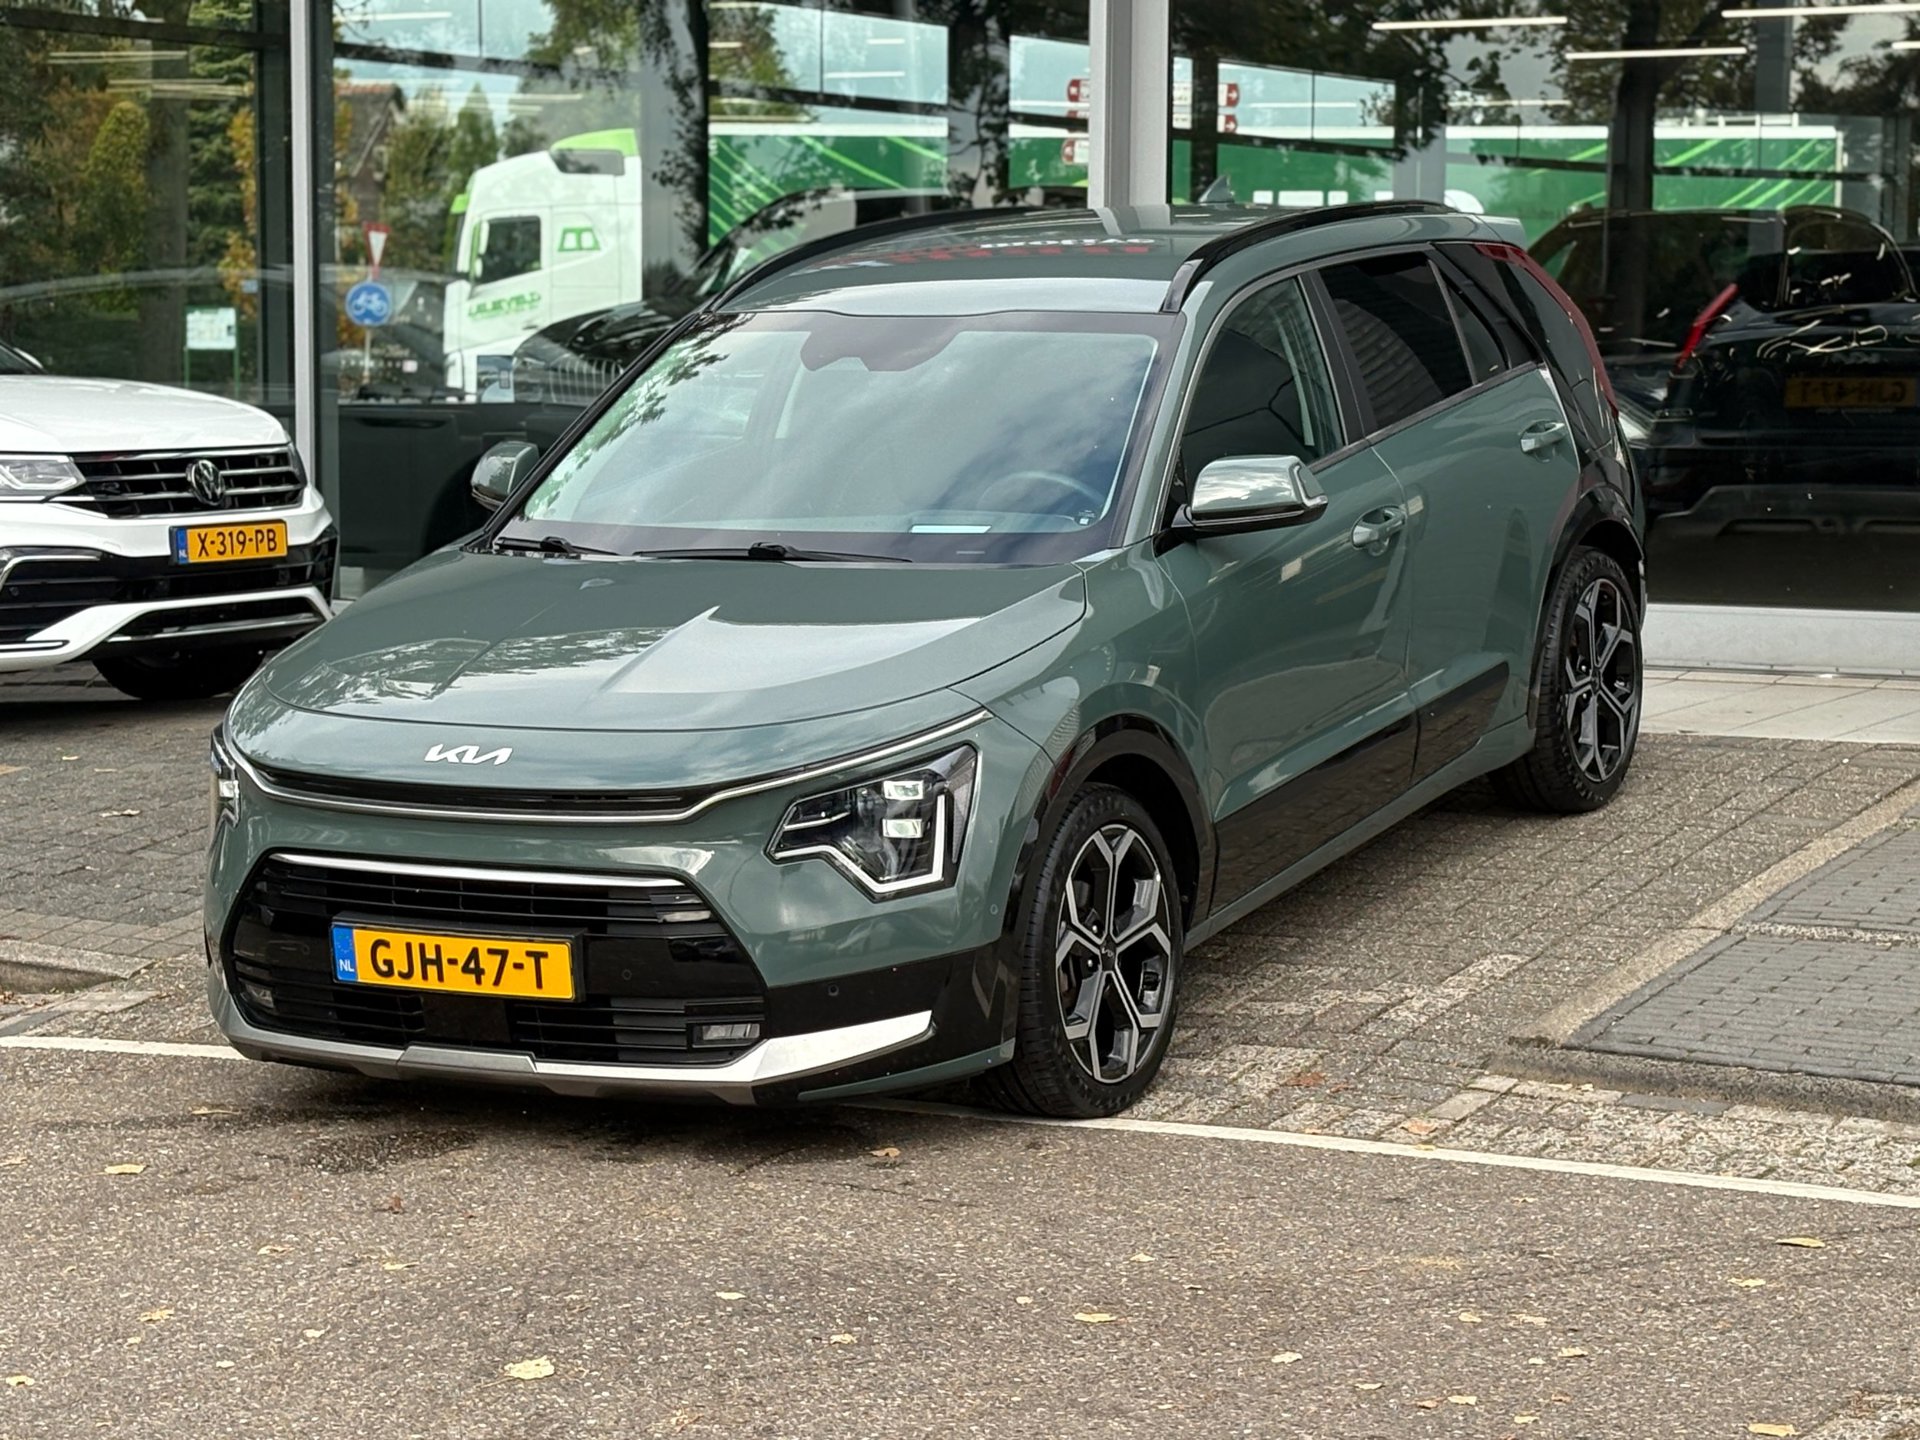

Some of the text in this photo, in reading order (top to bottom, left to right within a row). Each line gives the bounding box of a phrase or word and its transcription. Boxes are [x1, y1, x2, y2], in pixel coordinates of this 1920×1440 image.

[197, 528, 278, 557] X-319-PB
[424, 744, 513, 765] KIA
[338, 959, 355, 973] NL
[370, 938, 549, 990] GJH-47-T
